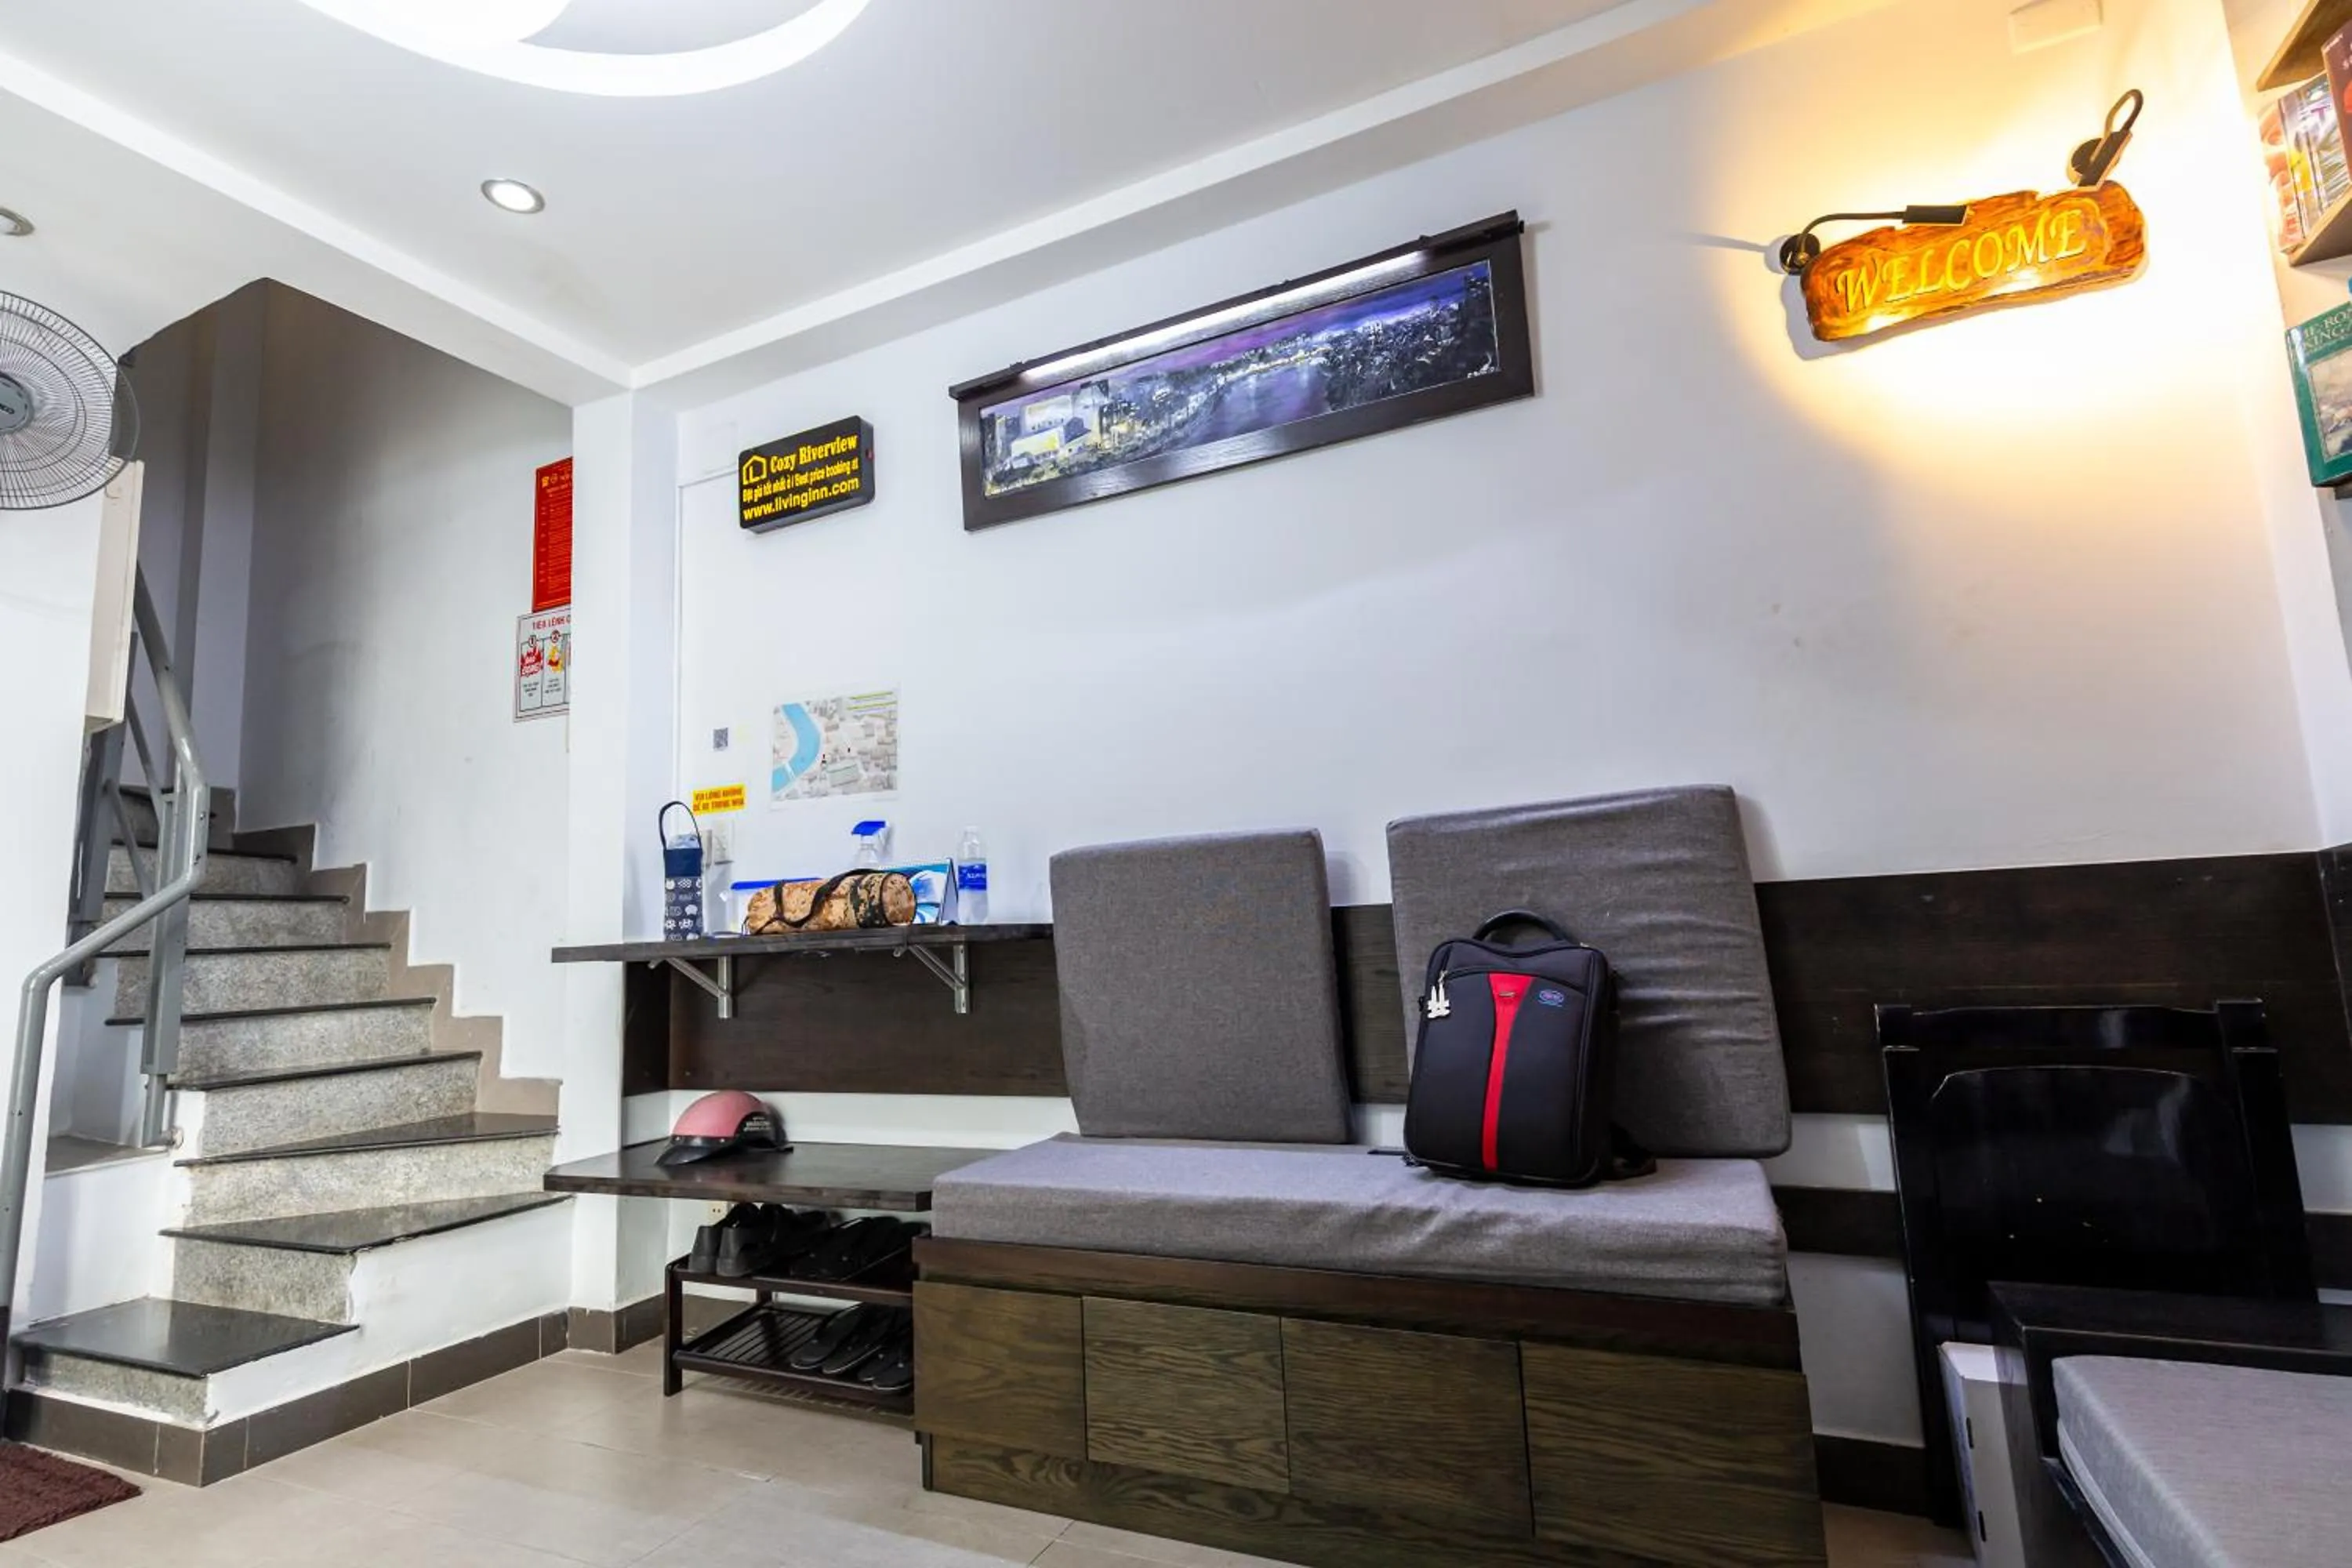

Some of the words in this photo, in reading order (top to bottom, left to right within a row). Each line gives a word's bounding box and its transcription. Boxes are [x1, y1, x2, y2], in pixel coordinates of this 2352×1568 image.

[1836, 210, 2087, 313] WELCOME
[770, 453, 797, 474] Cozy
[799, 435, 858, 465] Riverview
[743, 477, 859, 521] www.livinginn.com
